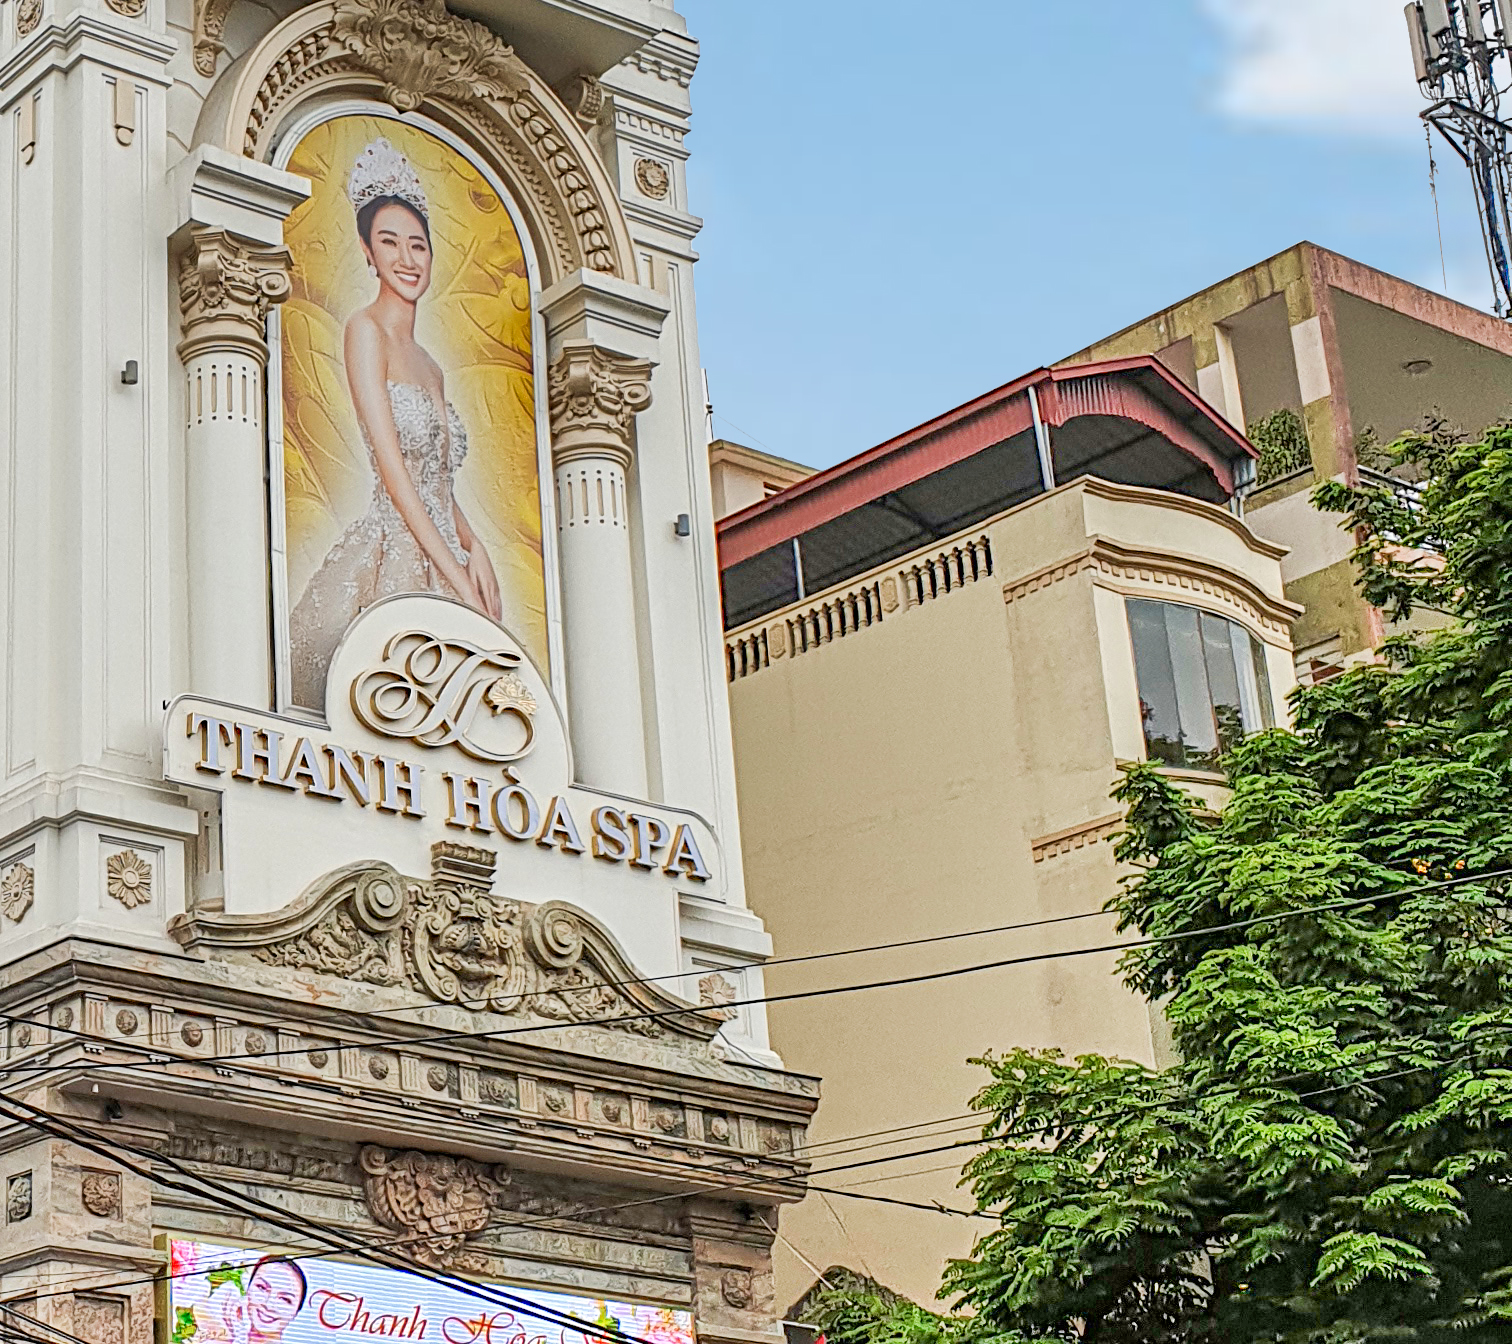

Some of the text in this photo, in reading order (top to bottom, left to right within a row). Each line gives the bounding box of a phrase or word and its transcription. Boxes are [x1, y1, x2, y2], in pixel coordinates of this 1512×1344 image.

[186, 711, 713, 882] THANH HÒA SPA
[309, 1287, 428, 1342] Thanh
